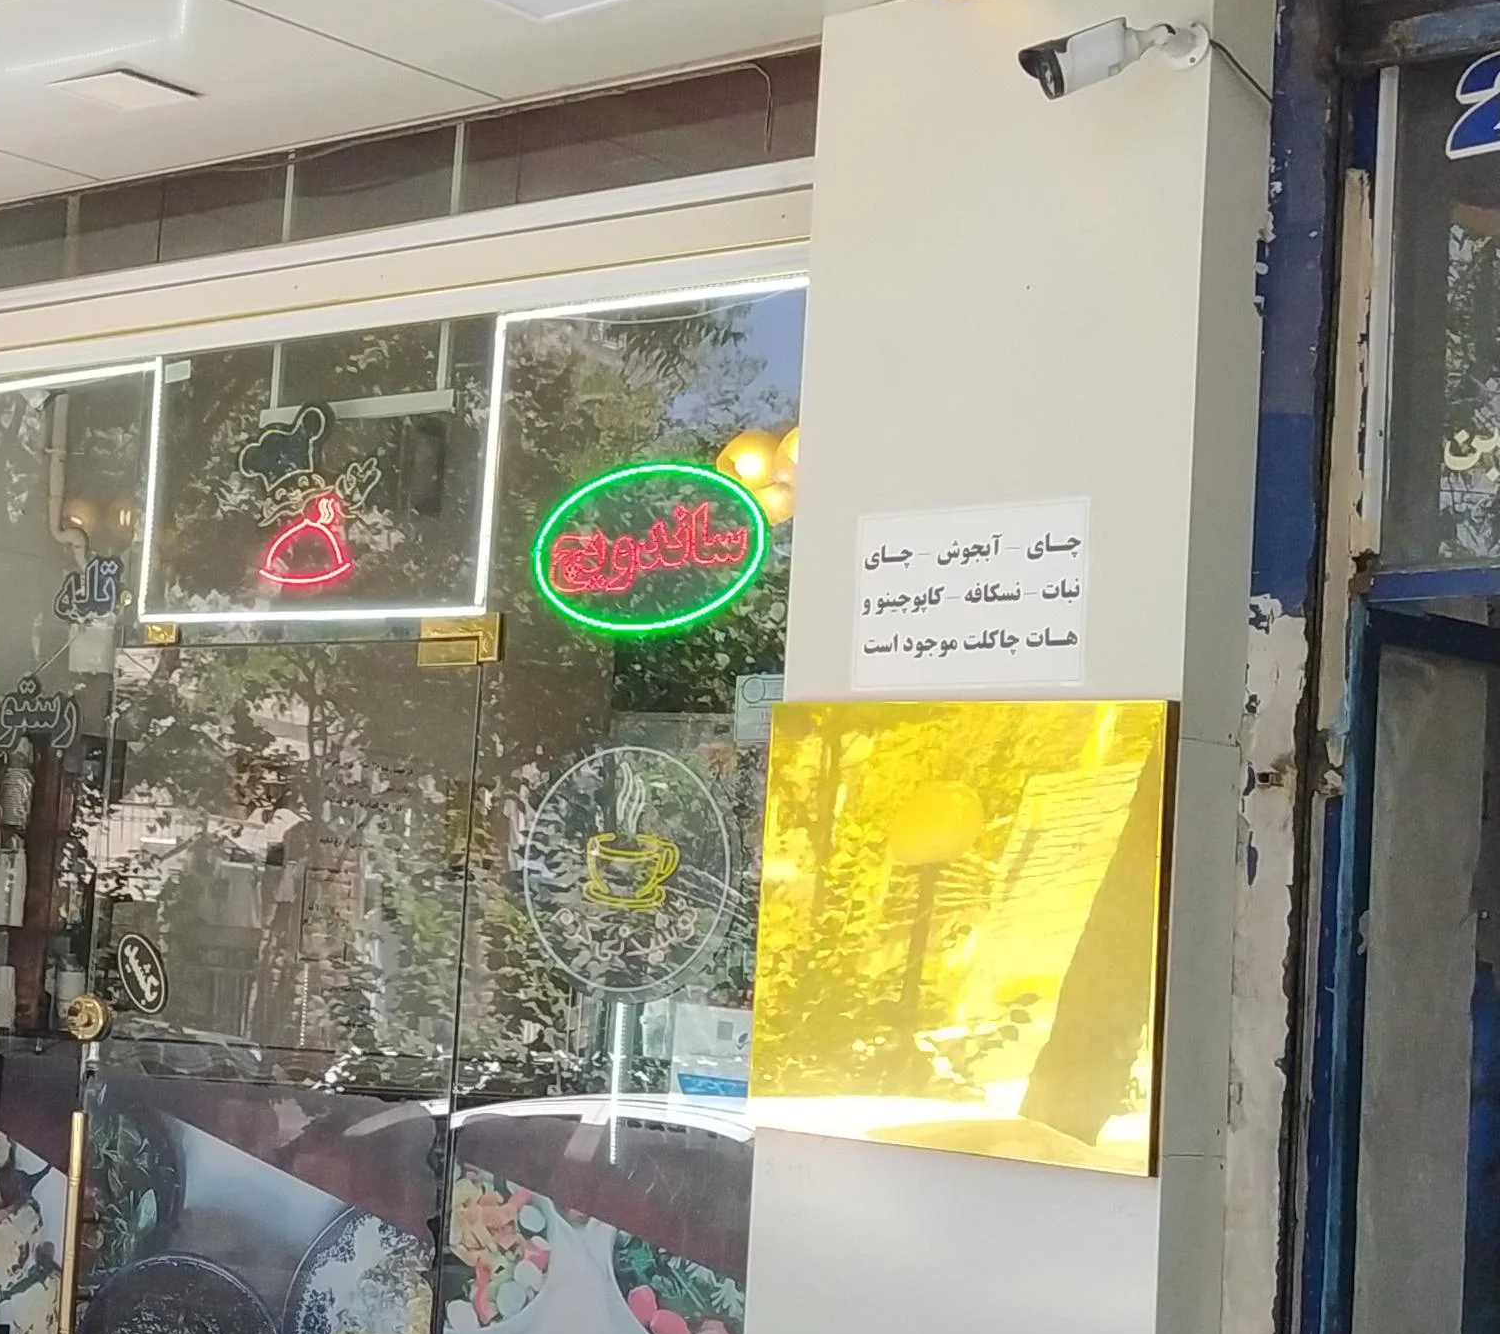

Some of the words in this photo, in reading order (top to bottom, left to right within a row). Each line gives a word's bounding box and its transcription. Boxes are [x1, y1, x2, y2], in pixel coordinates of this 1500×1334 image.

[550, 501, 747, 593] ساندویچ
[864, 544, 914, 571] چای
[936, 533, 1001, 566] آبجوش
[1026, 532, 1082, 561] چای
[875, 586, 945, 616] کاپوچینو
[964, 580, 1021, 604] نسکافه
[1041, 578, 1080, 601] نبات
[861, 599, 871, 616] و
[863, 635, 898, 655] است
[902, 635, 958, 658] موجود
[963, 628, 1020, 655] چاکلت
[1025, 626, 1079, 648] هات
[124, 944, 160, 1006] بکشید
